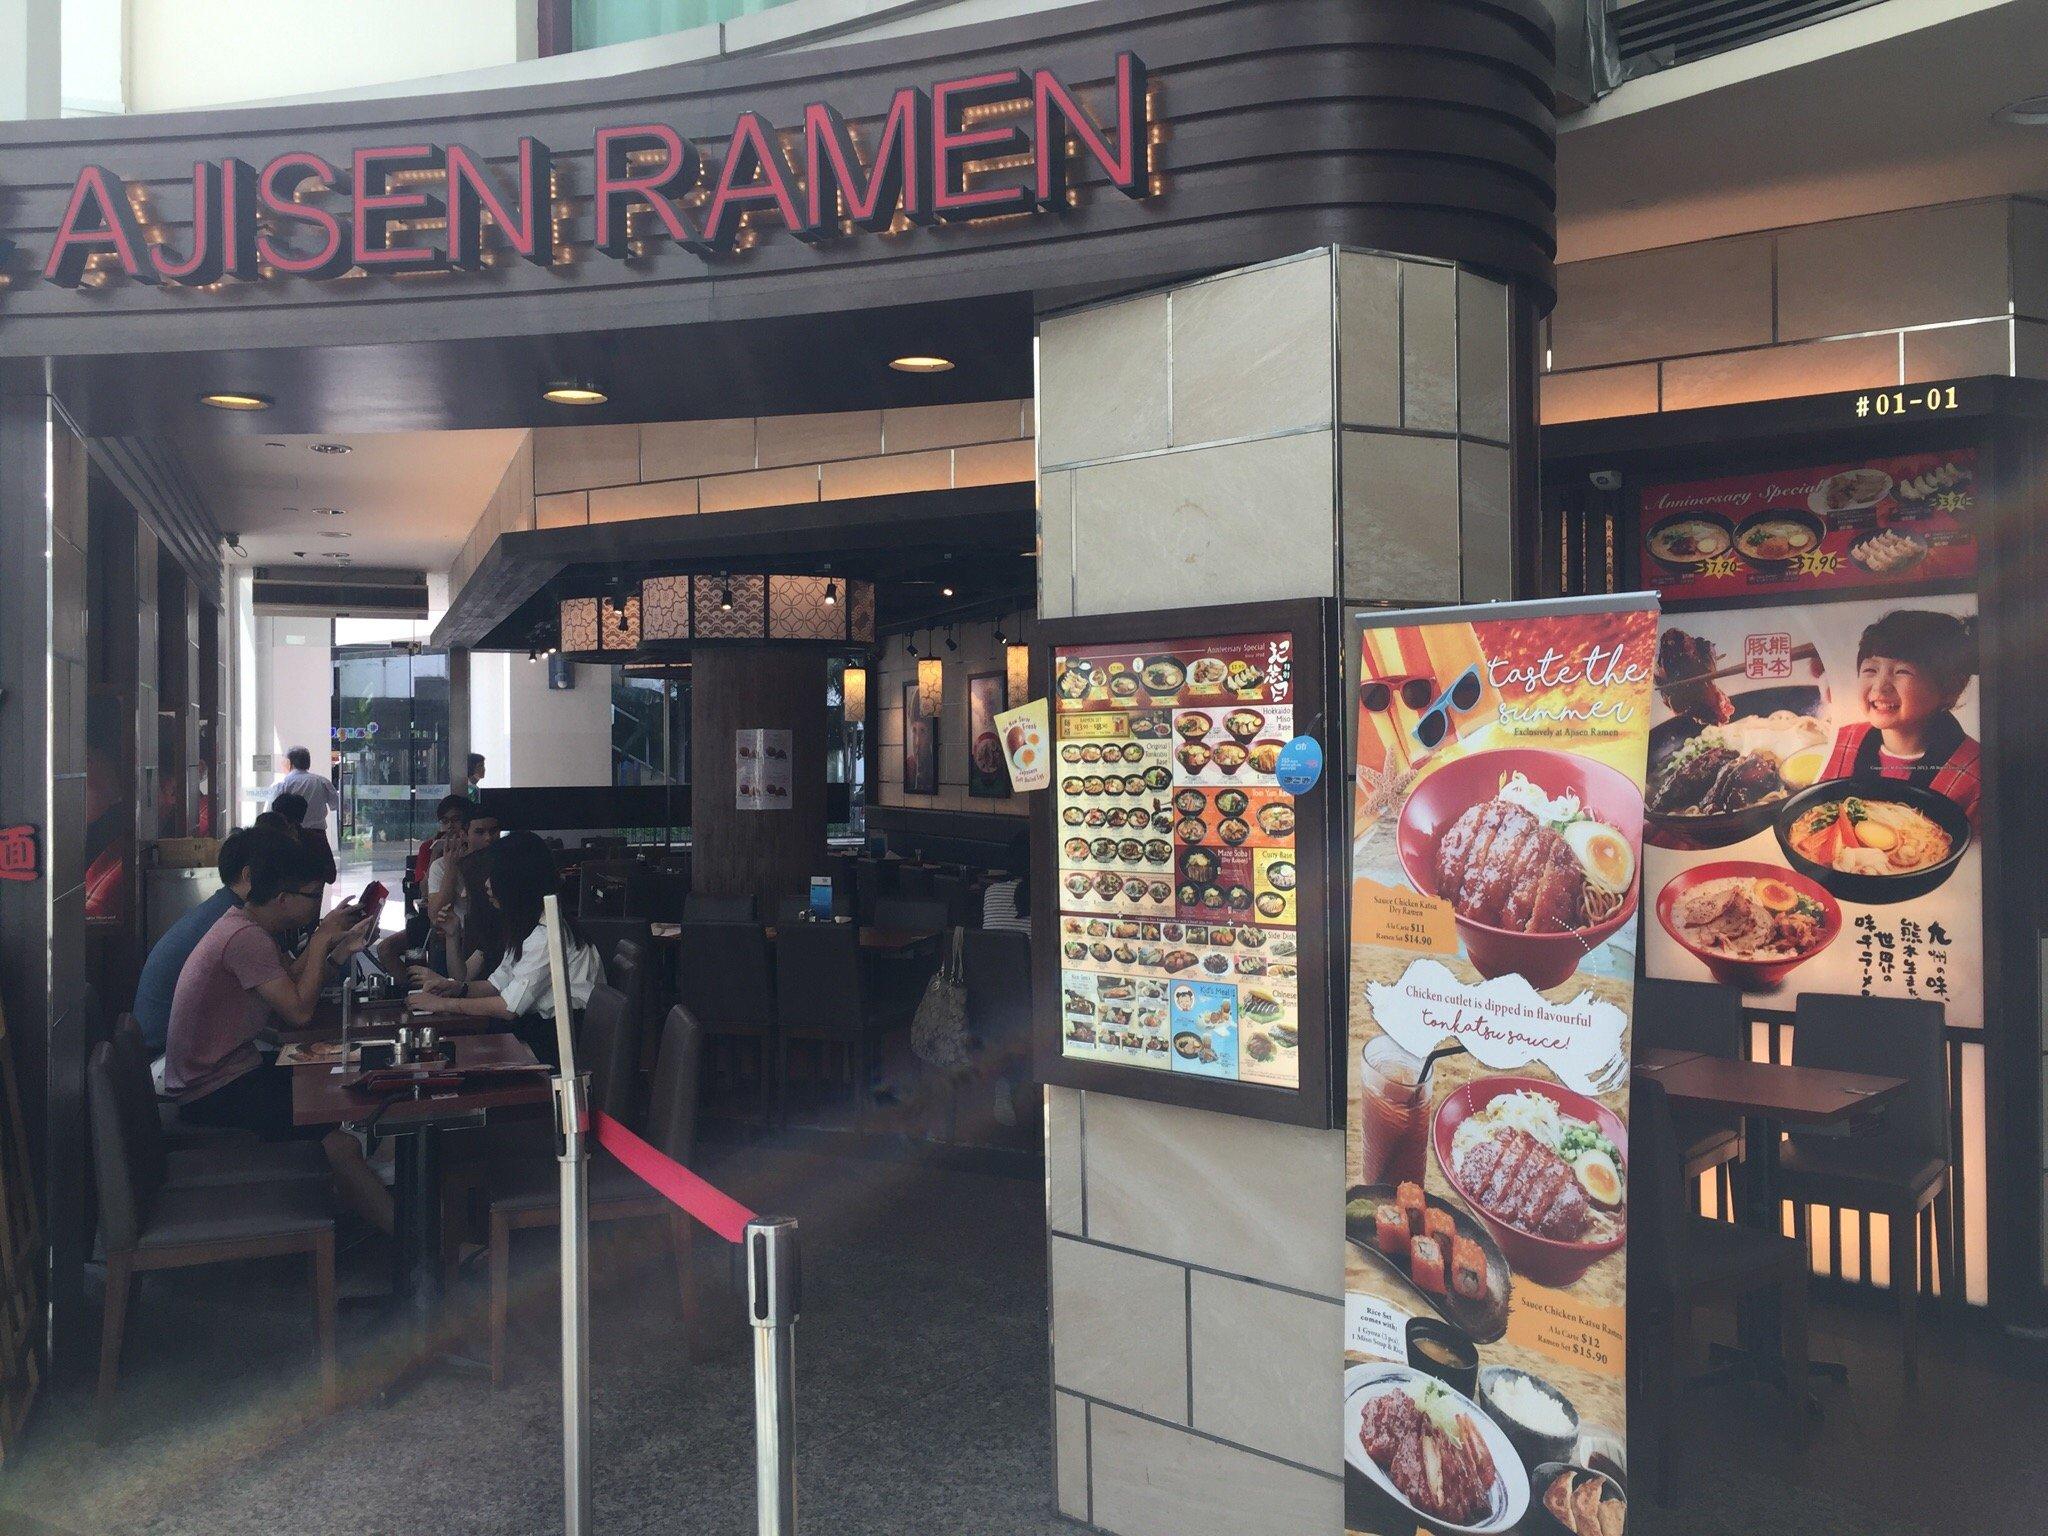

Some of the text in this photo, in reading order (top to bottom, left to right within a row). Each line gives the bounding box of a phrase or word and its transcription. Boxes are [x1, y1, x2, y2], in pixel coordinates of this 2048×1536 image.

[43, 50, 1134, 279] AJISEN RAMEN
[1856, 387, 1959, 418] #01-01
[1645, 479, 1825, 511] Anniversary Special
[1798, 556, 1837, 571] $7.90
[1244, 643, 1266, 653] Special
[1487, 643, 1648, 692] taste the
[1263, 707, 1291, 715] Hokkaido
[1499, 700, 1634, 726] summer
[1514, 728, 1555, 737] Exclusively
[1591, 728, 1619, 737] Ramen
[1262, 851, 1278, 859] Curry
[1374, 896, 1438, 910] Sauce Chicken Katsu
[1389, 905, 1423, 917] Dry Ramen
[1410, 923, 1425, 933] $11
[1283, 932, 1296, 940] Dish
[1404, 934, 1432, 946] $14.90
[1217, 986, 1230, 995] Meal
[1405, 985, 1592, 1027] Chicken cutlet is dipped in flavourful
[1422, 1009, 1571, 1050] tonkatsu sauce!
[1360, 1315, 1381, 1325] comes
[1366, 1307, 1392, 1320] Rice Set
[1521, 1297, 1623, 1341] Sauce Chicken Katsu Ramen
[1562, 1329, 1579, 1342] Carte
[1581, 1333, 1600, 1349] $12
[1537, 1334, 1608, 1365] Ramen Set $15.90
